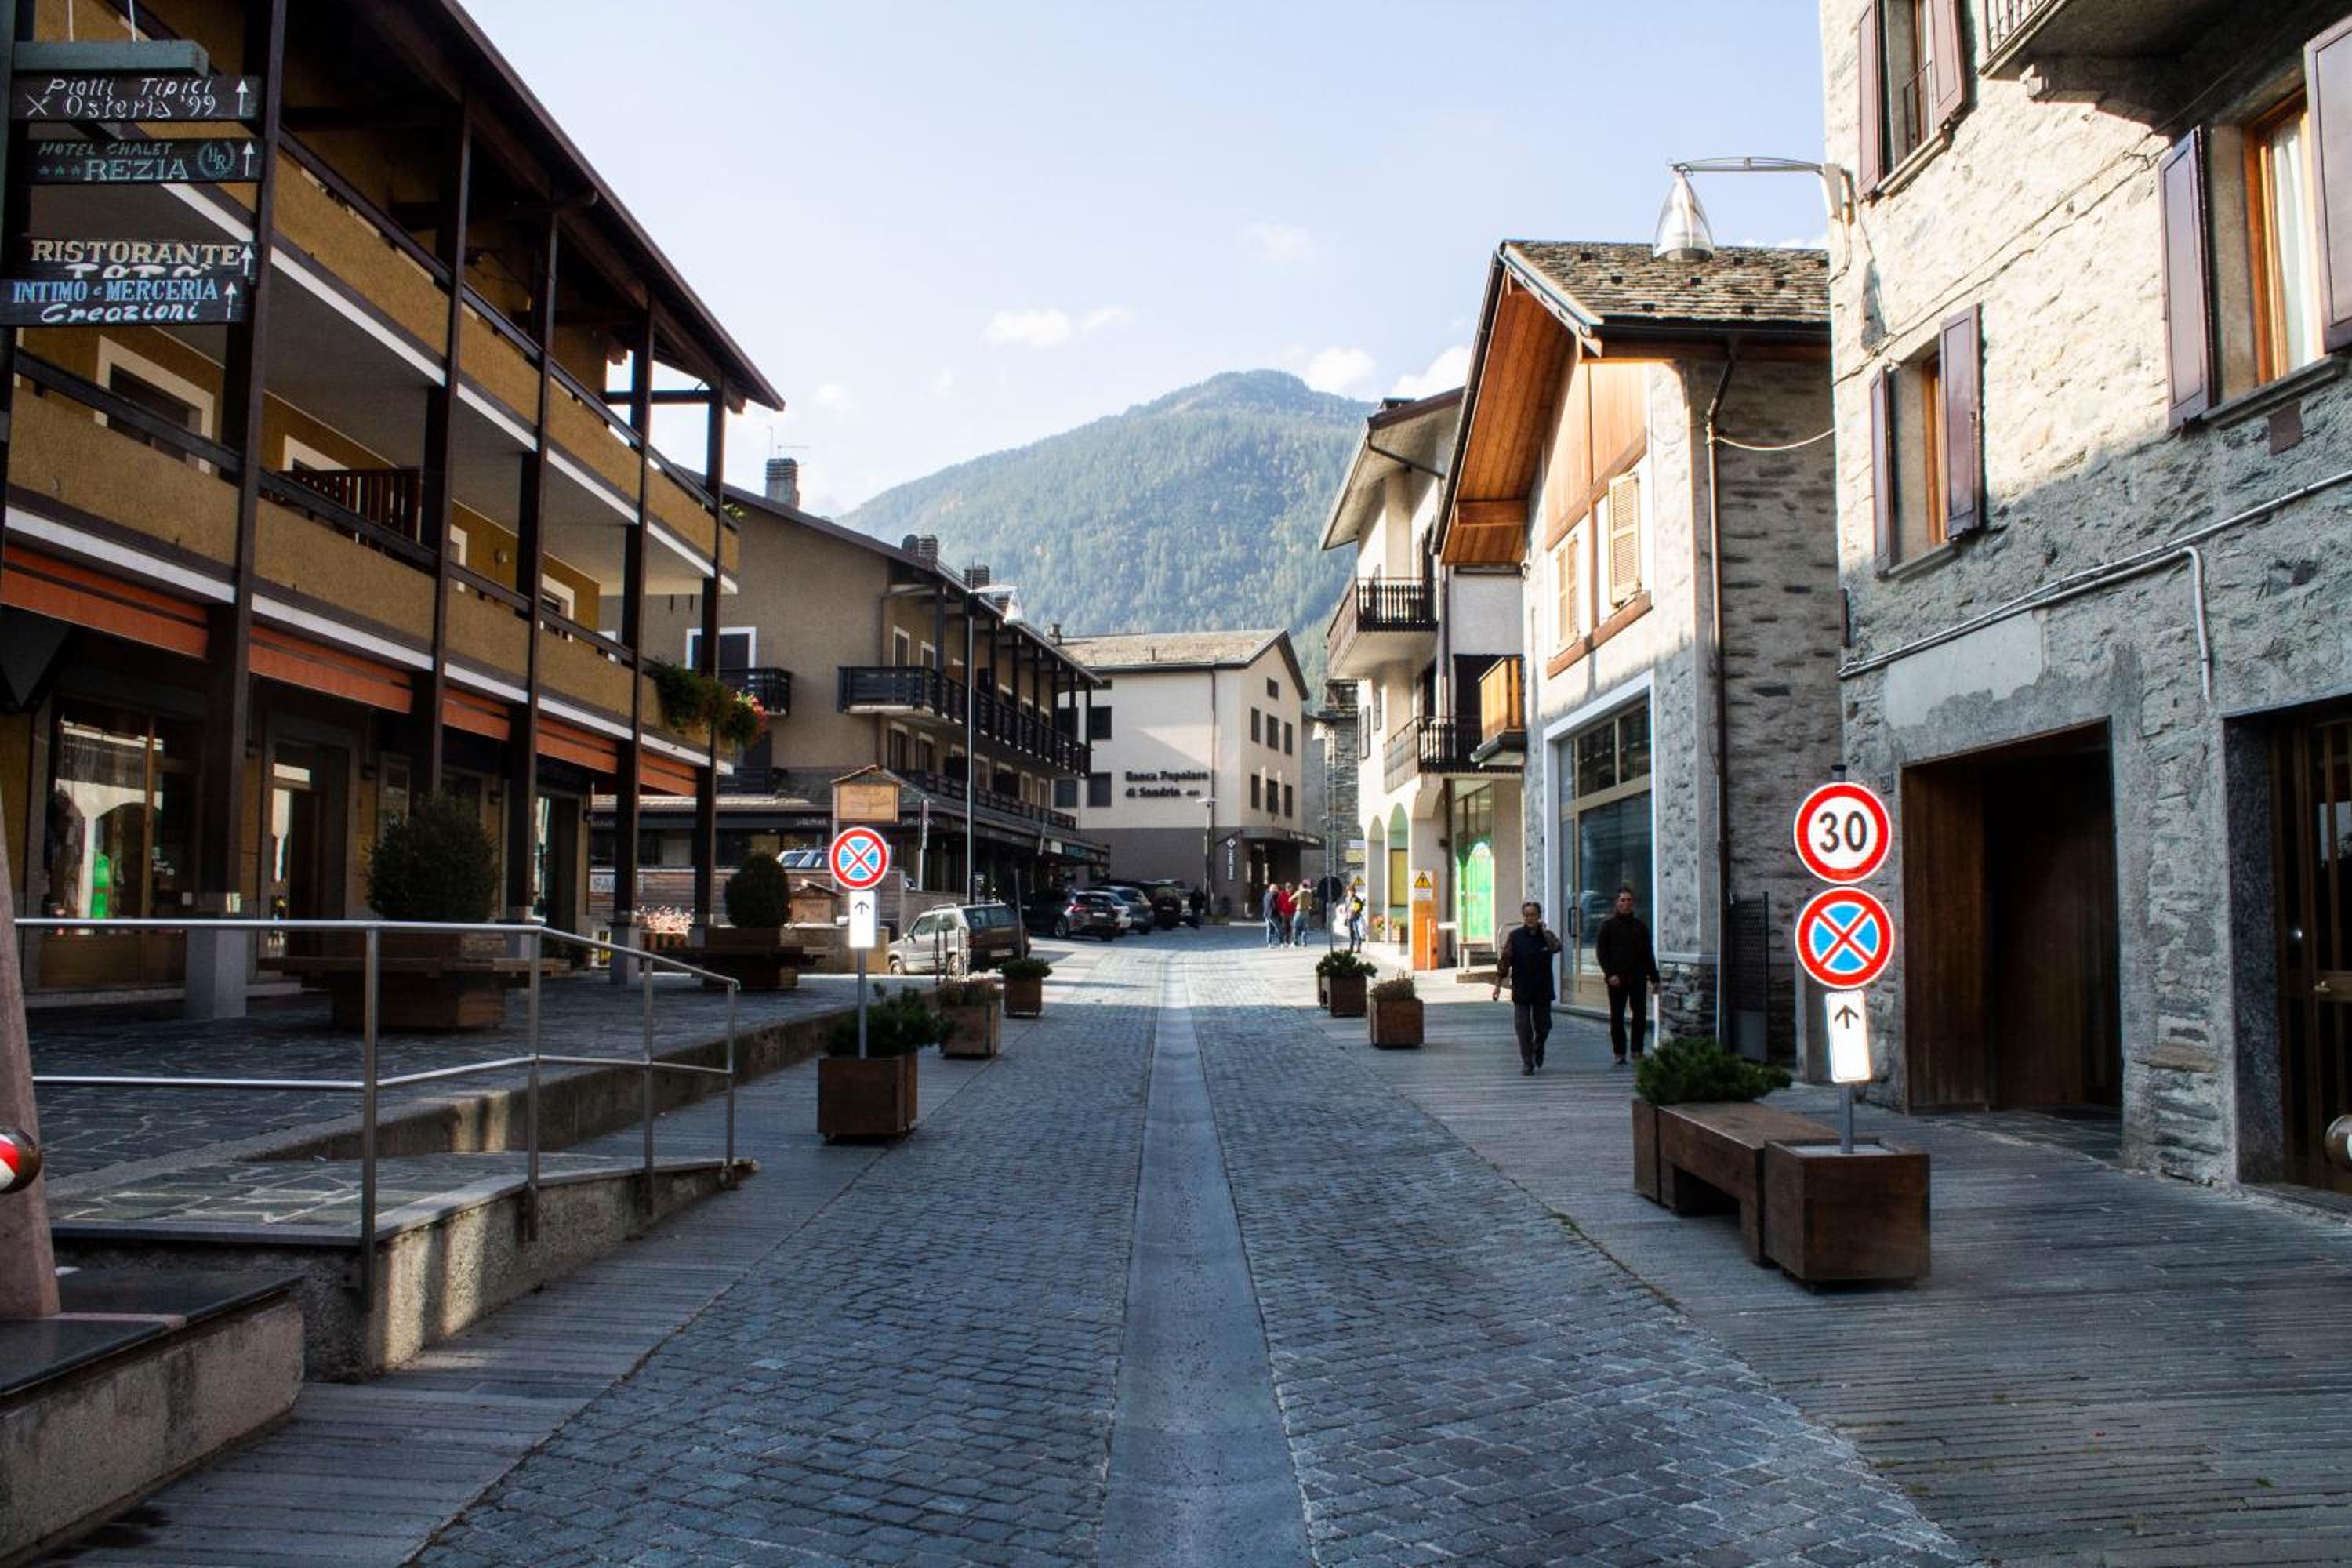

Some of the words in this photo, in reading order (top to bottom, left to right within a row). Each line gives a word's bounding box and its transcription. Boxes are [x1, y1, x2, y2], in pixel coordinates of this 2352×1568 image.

[140, 78, 213, 96] Tipici
[38, 141, 96, 156] HOTEL
[106, 141, 173, 156] CHALET
[83, 158, 190, 181] REZIA
[31, 239, 242, 266] RISTORANTE
[13, 281, 88, 303] INTIMO
[106, 278, 219, 301] MERCERIA
[40, 301, 200, 324] Creazioni
[1125, 771, 1157, 781] Banca
[1139, 786, 1181, 797] Sondrio
[1818, 811, 1867, 854] 30
